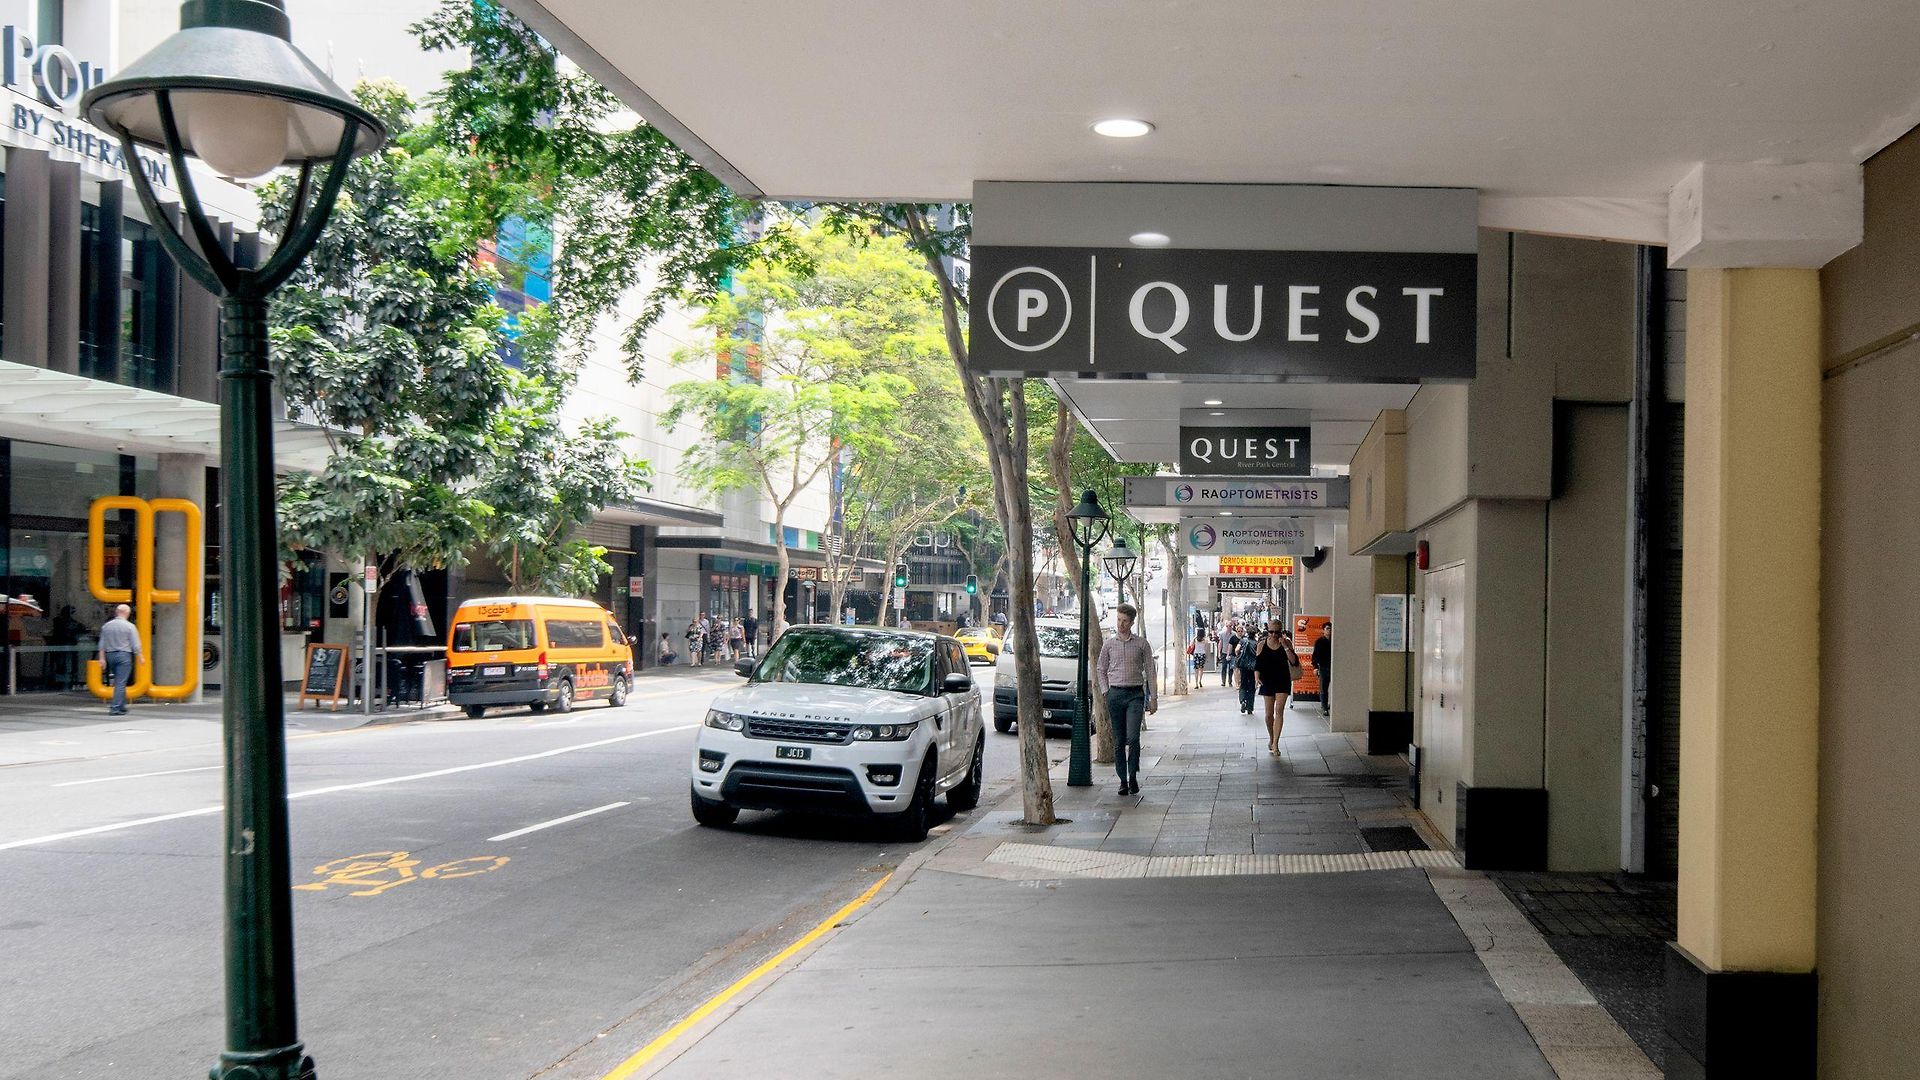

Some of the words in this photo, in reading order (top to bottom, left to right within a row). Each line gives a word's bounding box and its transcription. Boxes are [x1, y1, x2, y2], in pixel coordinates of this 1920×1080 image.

[13, 103, 44, 135] BY
[52, 120, 167, 186] SHERAON
[1017, 288, 1049, 332] P
[1128, 281, 1444, 354] QUEST
[1190, 437, 1300, 463] QUEST
[1201, 489, 1318, 500] RAOPTOMETRISTS
[1222, 530, 1305, 538] RAOPTOMETRISTS
[1220, 557, 1248, 565] FORMOSA
[1249, 557, 1267, 565] ASIAN
[1221, 581, 1261, 589] BARBER
[478, 606, 510, 615] 13cabs
[576, 663, 609, 687] 13cabs
[752, 710, 795, 718] RANGE
[787, 748, 804, 758] JC13
